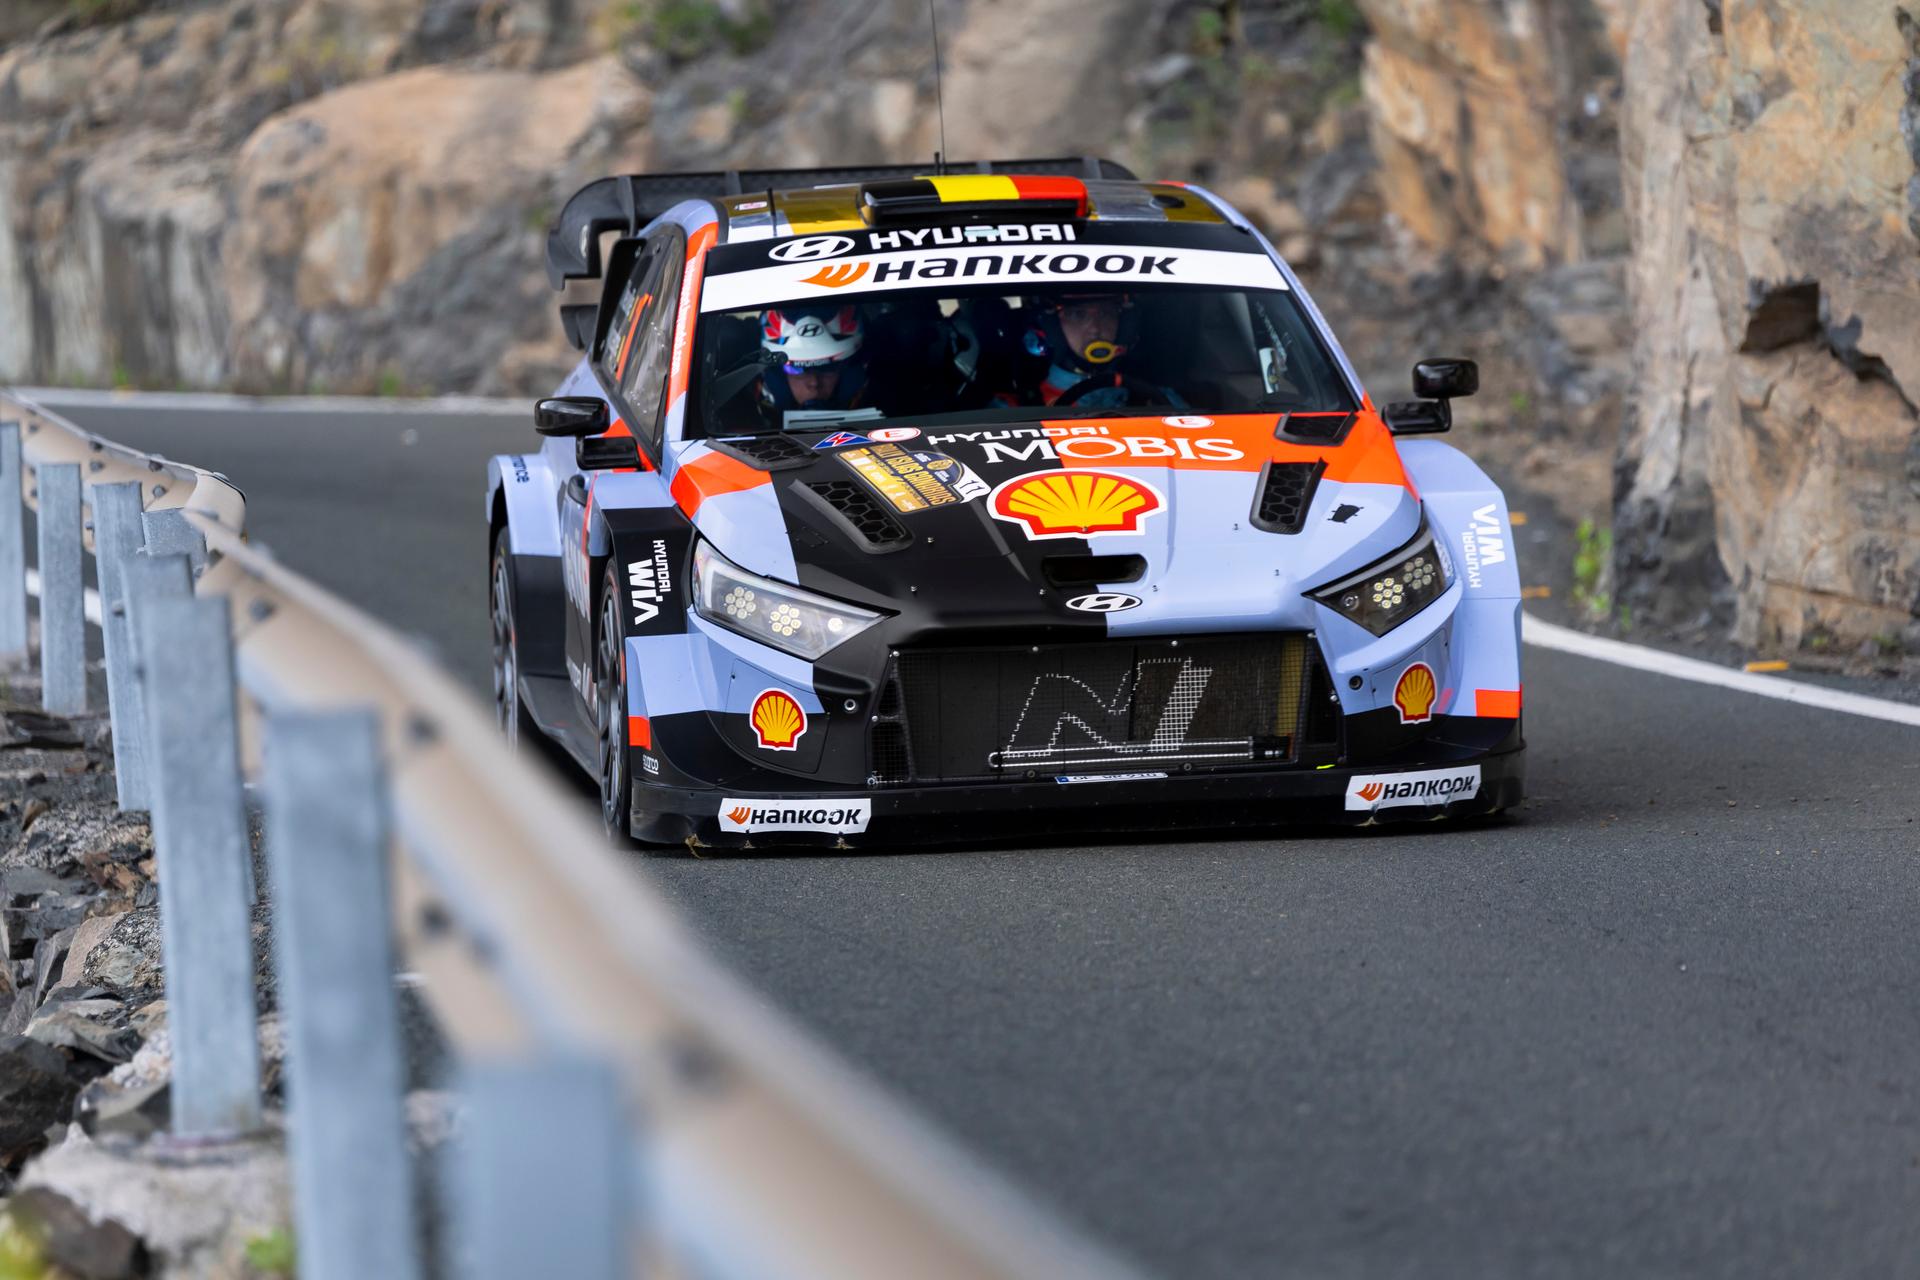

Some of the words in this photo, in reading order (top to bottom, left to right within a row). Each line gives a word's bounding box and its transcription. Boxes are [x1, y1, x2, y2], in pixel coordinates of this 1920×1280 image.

[869, 224, 1076, 251] HYUNDAI
[928, 426, 1109, 445] HYUNDAI
[979, 437, 1245, 464] MOBIS
[652, 539, 671, 592] HYUNDAI
[1462, 531, 1482, 588] HYUNDAI
